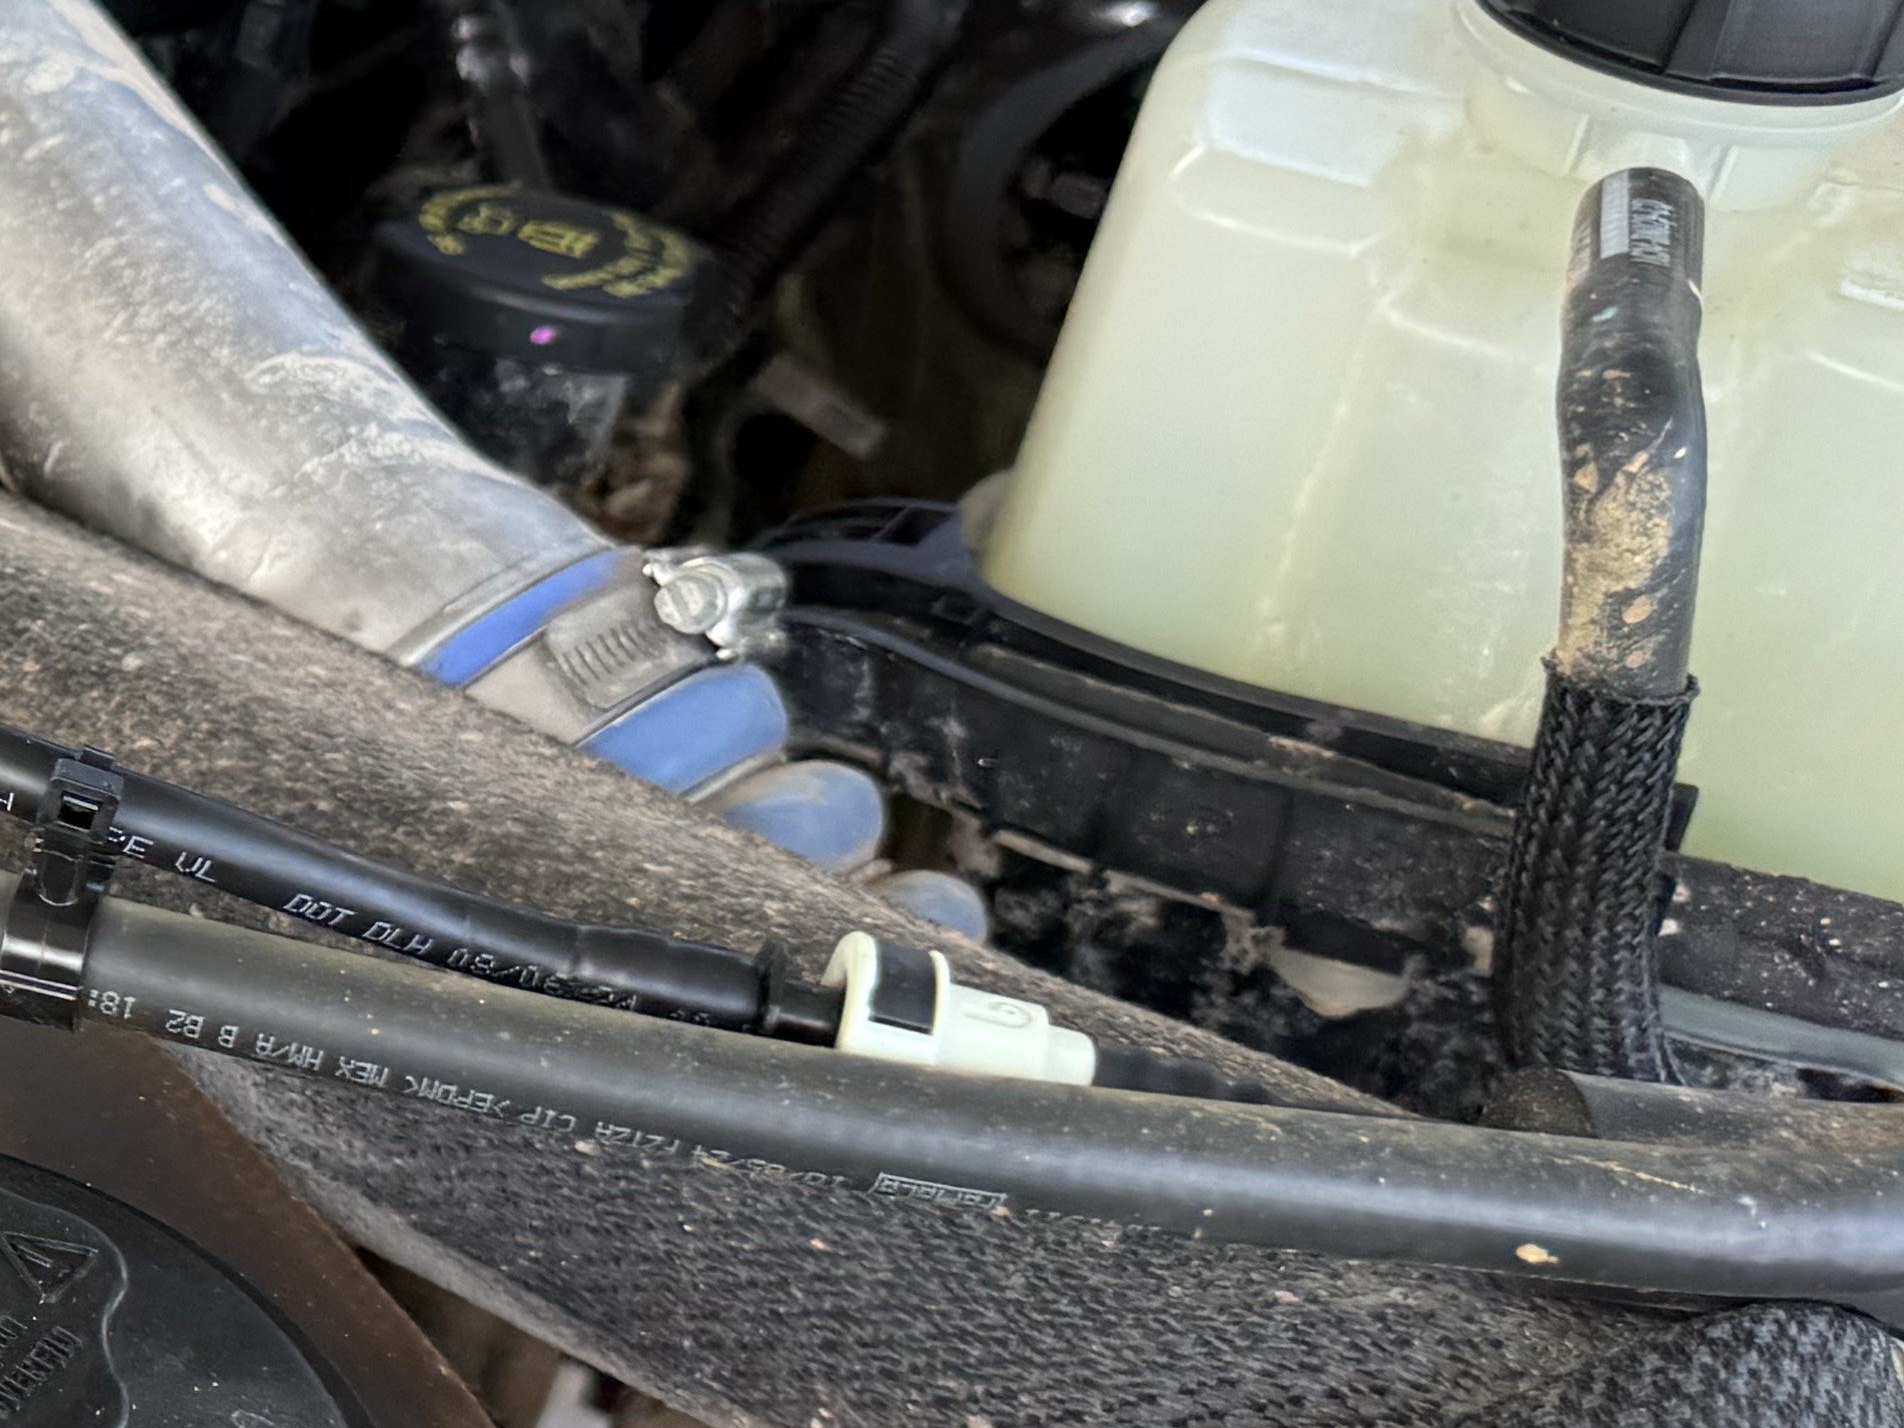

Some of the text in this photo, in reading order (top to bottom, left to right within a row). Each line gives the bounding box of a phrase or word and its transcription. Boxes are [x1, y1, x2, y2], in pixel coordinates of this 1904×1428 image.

[281, 891, 356, 933] DOT
[165, 1007, 206, 1041] B2
[217, 1022, 242, 1051] B
[255, 1031, 324, 1073] HM/A
[333, 1053, 390, 1089] MEX
